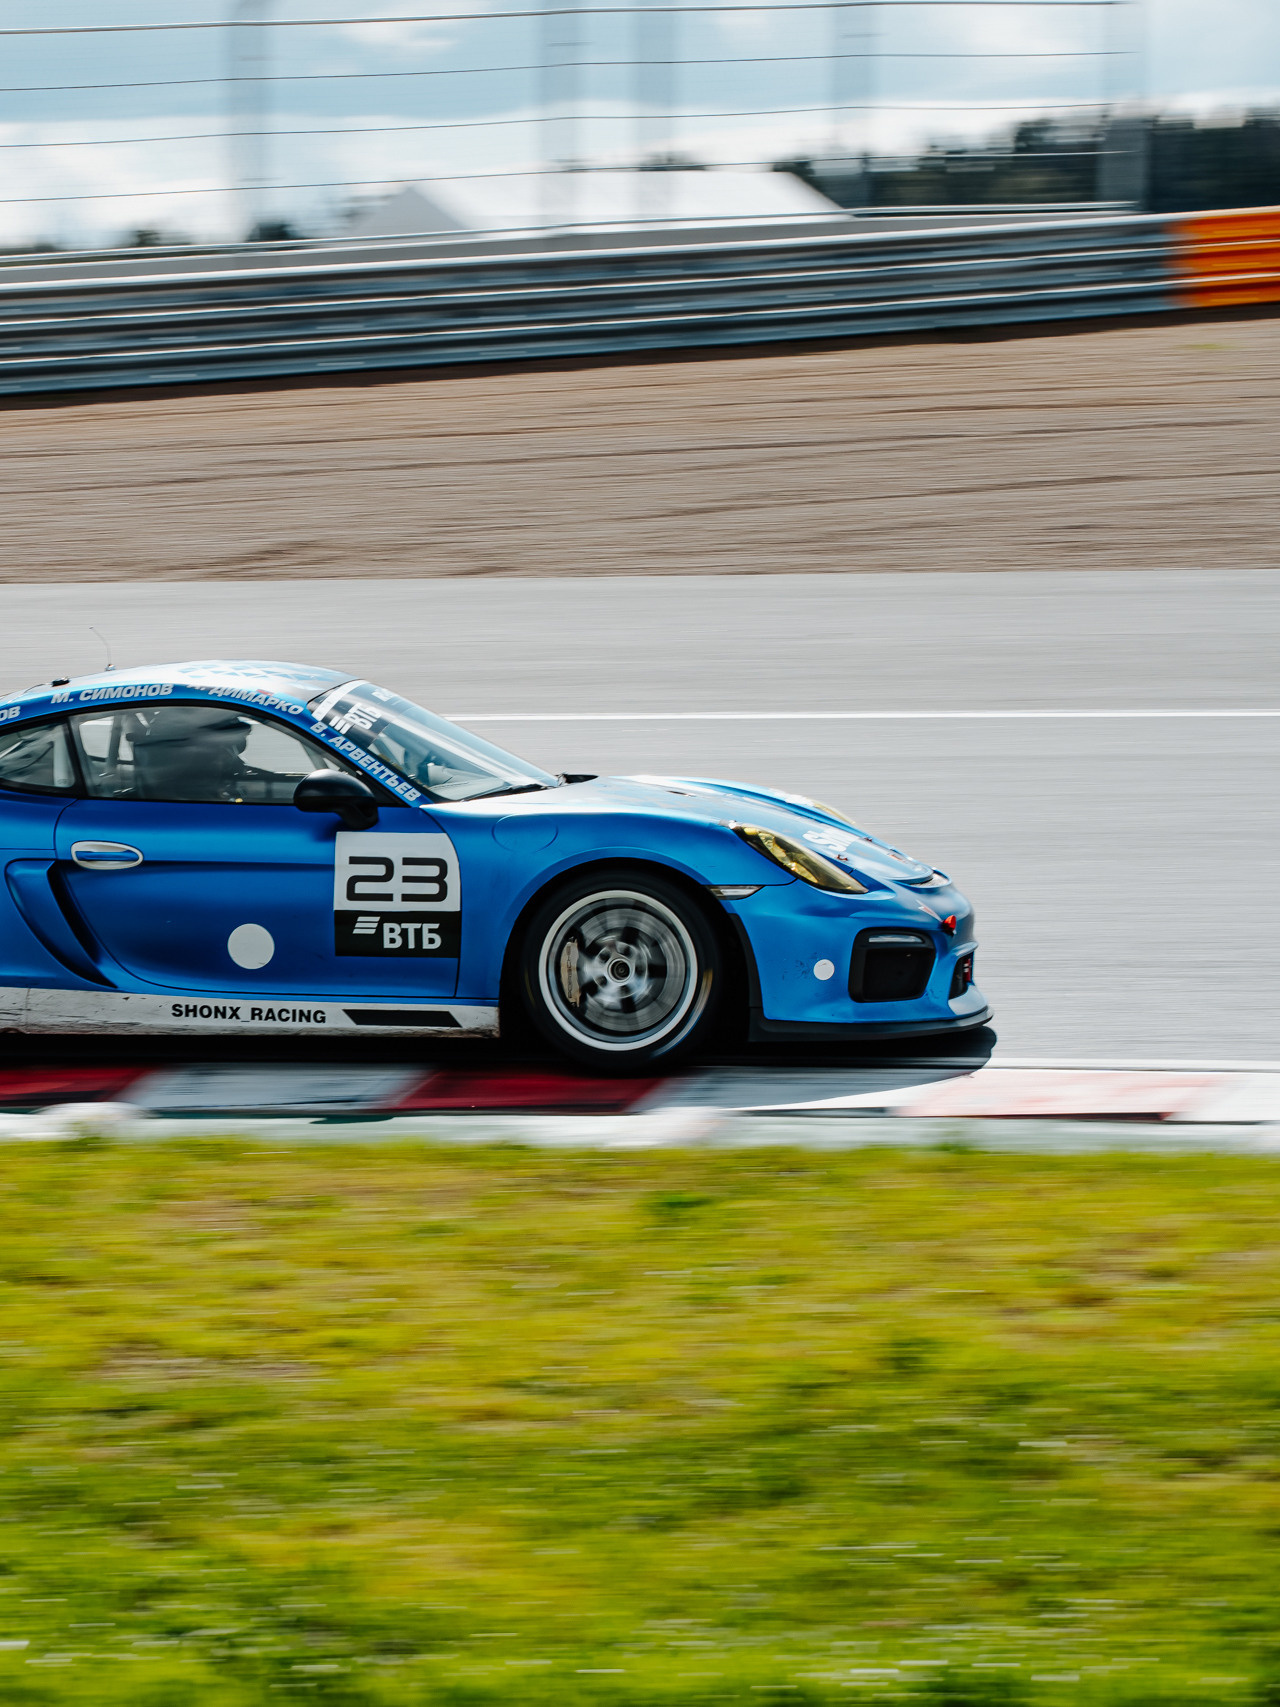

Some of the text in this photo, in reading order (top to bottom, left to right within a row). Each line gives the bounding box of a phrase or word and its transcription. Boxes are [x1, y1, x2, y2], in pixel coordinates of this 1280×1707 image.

[50, 683, 174, 704] М. СИМОНОВ
[207, 686, 304, 715] ДИМАРКО
[310, 721, 422, 802] В. АРВЕНТЬЕВ
[346, 855, 448, 902] 23
[383, 922, 442, 950] ВТБ
